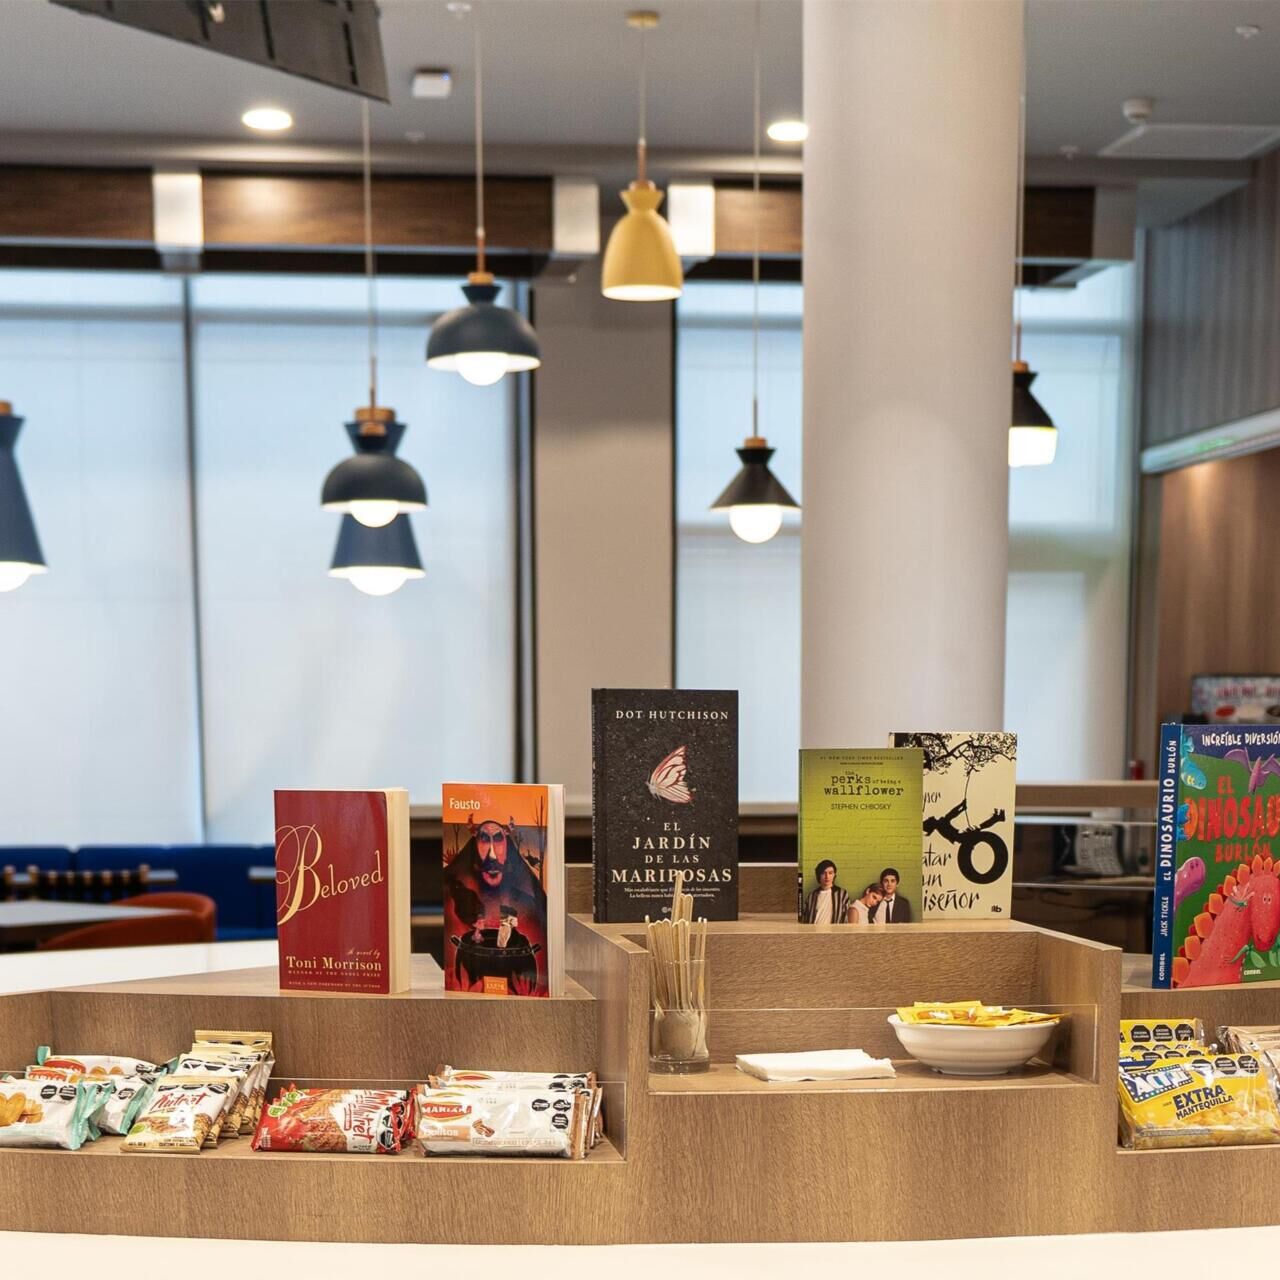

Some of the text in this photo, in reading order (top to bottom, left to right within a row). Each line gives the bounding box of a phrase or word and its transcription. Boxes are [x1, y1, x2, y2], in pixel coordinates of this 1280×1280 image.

[616, 710, 728, 720] DOT HUTCHISON
[1202, 732, 1242, 746] INCREÍBLE
[831, 774, 871, 786] perks
[1217, 776, 1234, 794] EL
[824, 785, 904, 795] wallflower
[450, 798, 480, 810] Fausto
[1160, 779, 1175, 868] DINOSAURIO
[1168, 740, 1177, 773] BURLÓN
[664, 822, 681, 831] EL
[632, 833, 710, 849] JARDÍN
[645, 855, 699, 863] DE LAS
[922, 843, 951, 867] atar
[275, 824, 384, 926] Beloved
[612, 868, 732, 882] MARIPOSAS
[924, 890, 980, 912] iseñor
[286, 956, 382, 971] Toni Morrison
[1173, 1085, 1225, 1110] EXTRA
[1176, 1095, 1234, 1120] MANTEQUILLA
